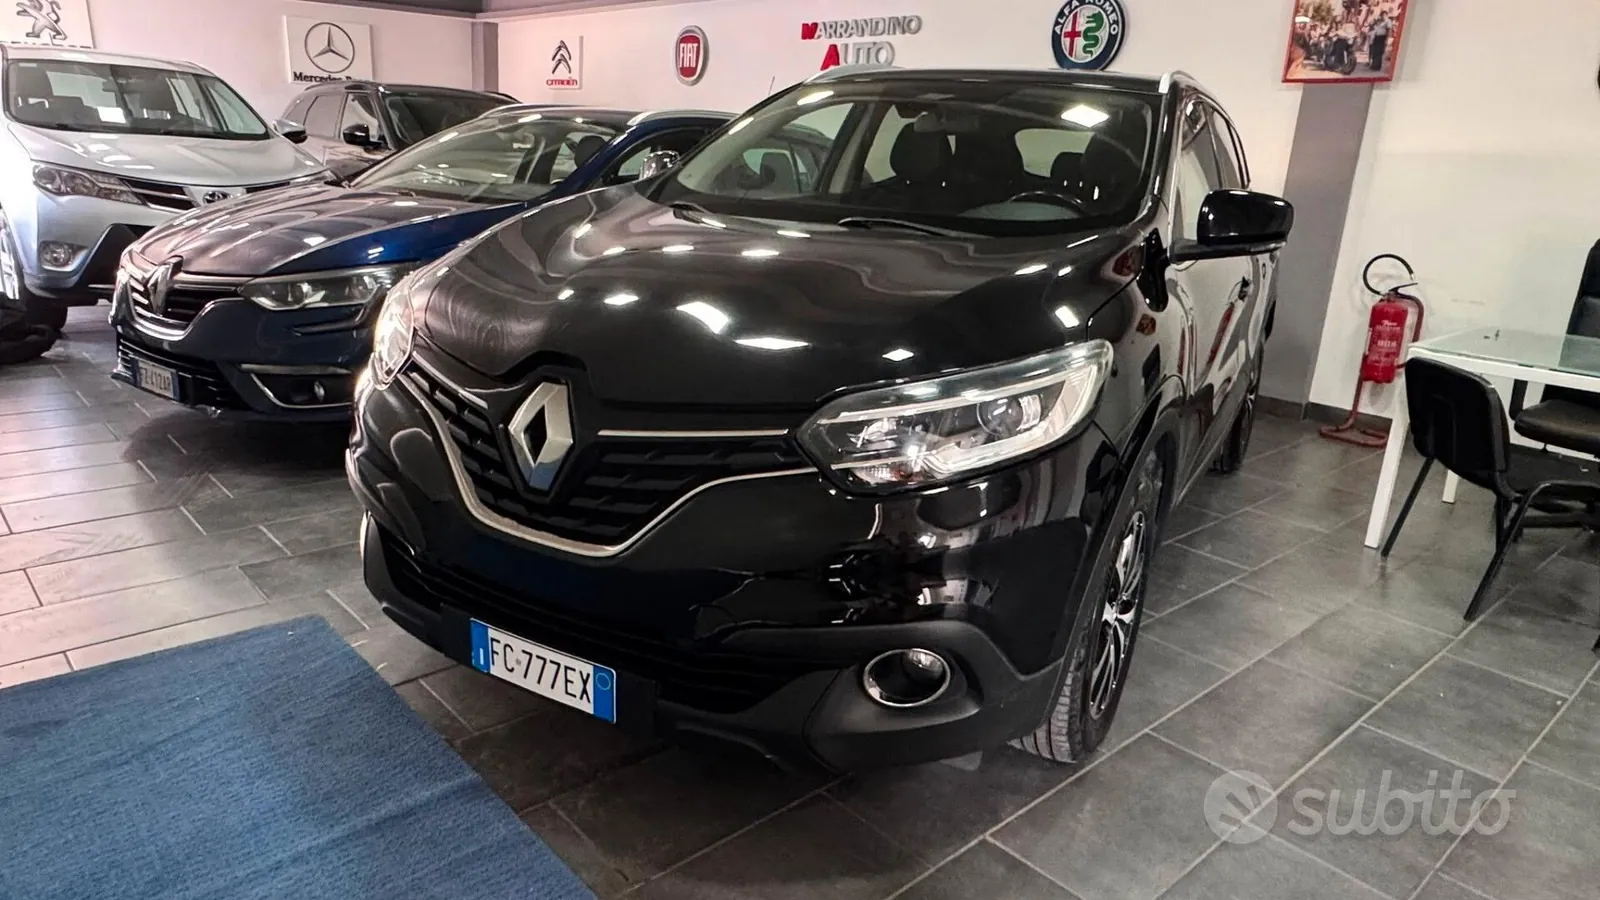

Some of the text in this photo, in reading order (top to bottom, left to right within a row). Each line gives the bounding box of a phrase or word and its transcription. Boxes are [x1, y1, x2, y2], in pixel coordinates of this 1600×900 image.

[801, 15, 922, 40] MARRANDINO
[679, 43, 699, 67] FIAT
[820, 40, 896, 71] AUTO
